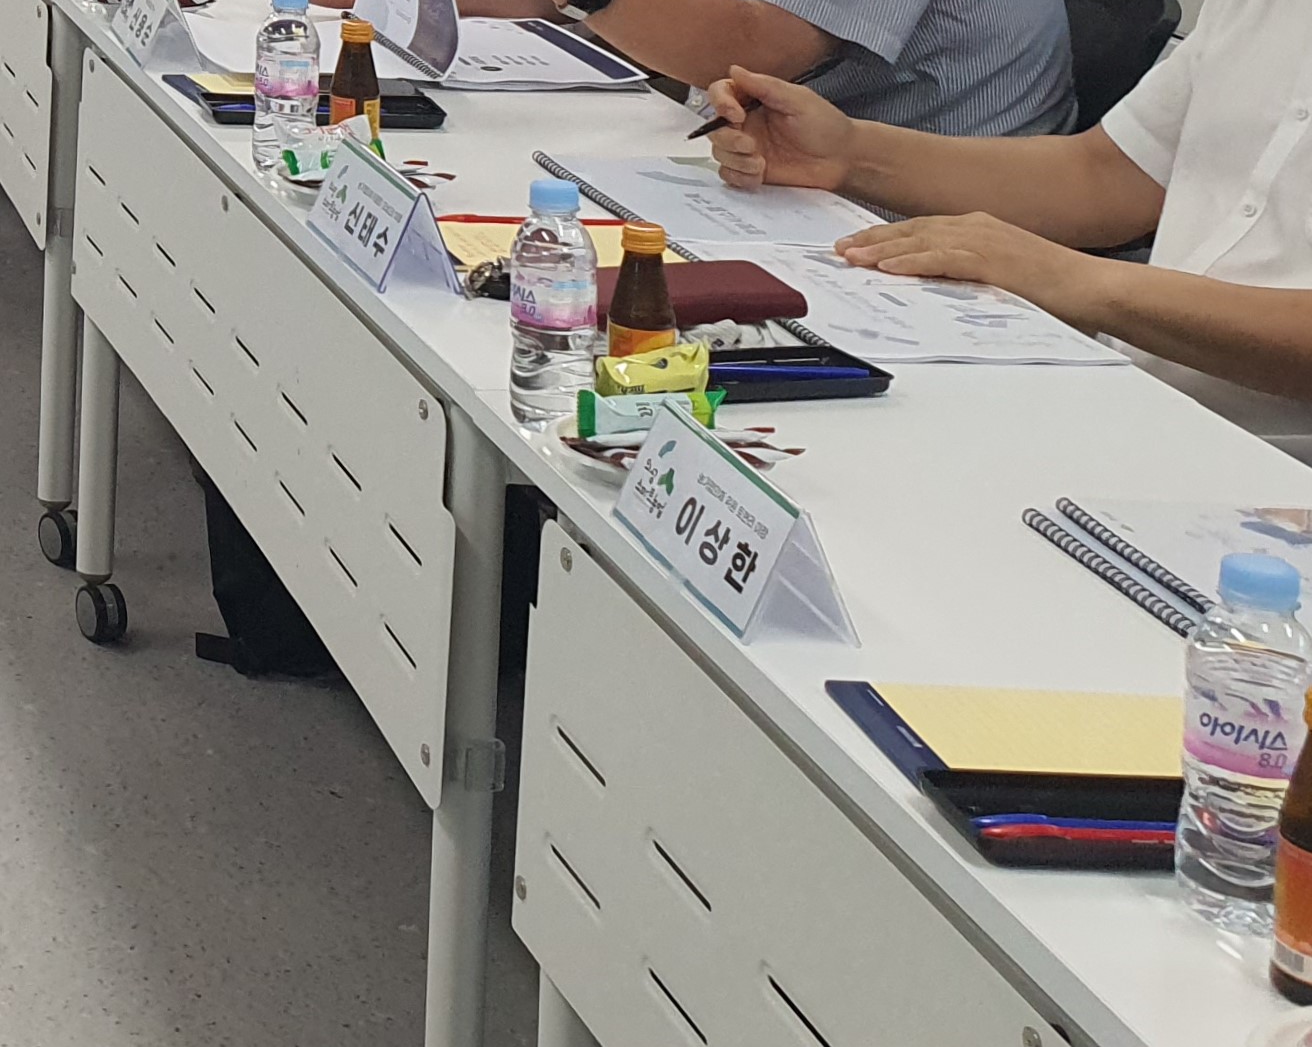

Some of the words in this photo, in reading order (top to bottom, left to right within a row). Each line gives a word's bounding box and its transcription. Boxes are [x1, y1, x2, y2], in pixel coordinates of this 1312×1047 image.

[343, 201, 390, 259] 신태수
[674, 495, 760, 595] 이상한
[1198, 712, 1289, 751] 아이시스
